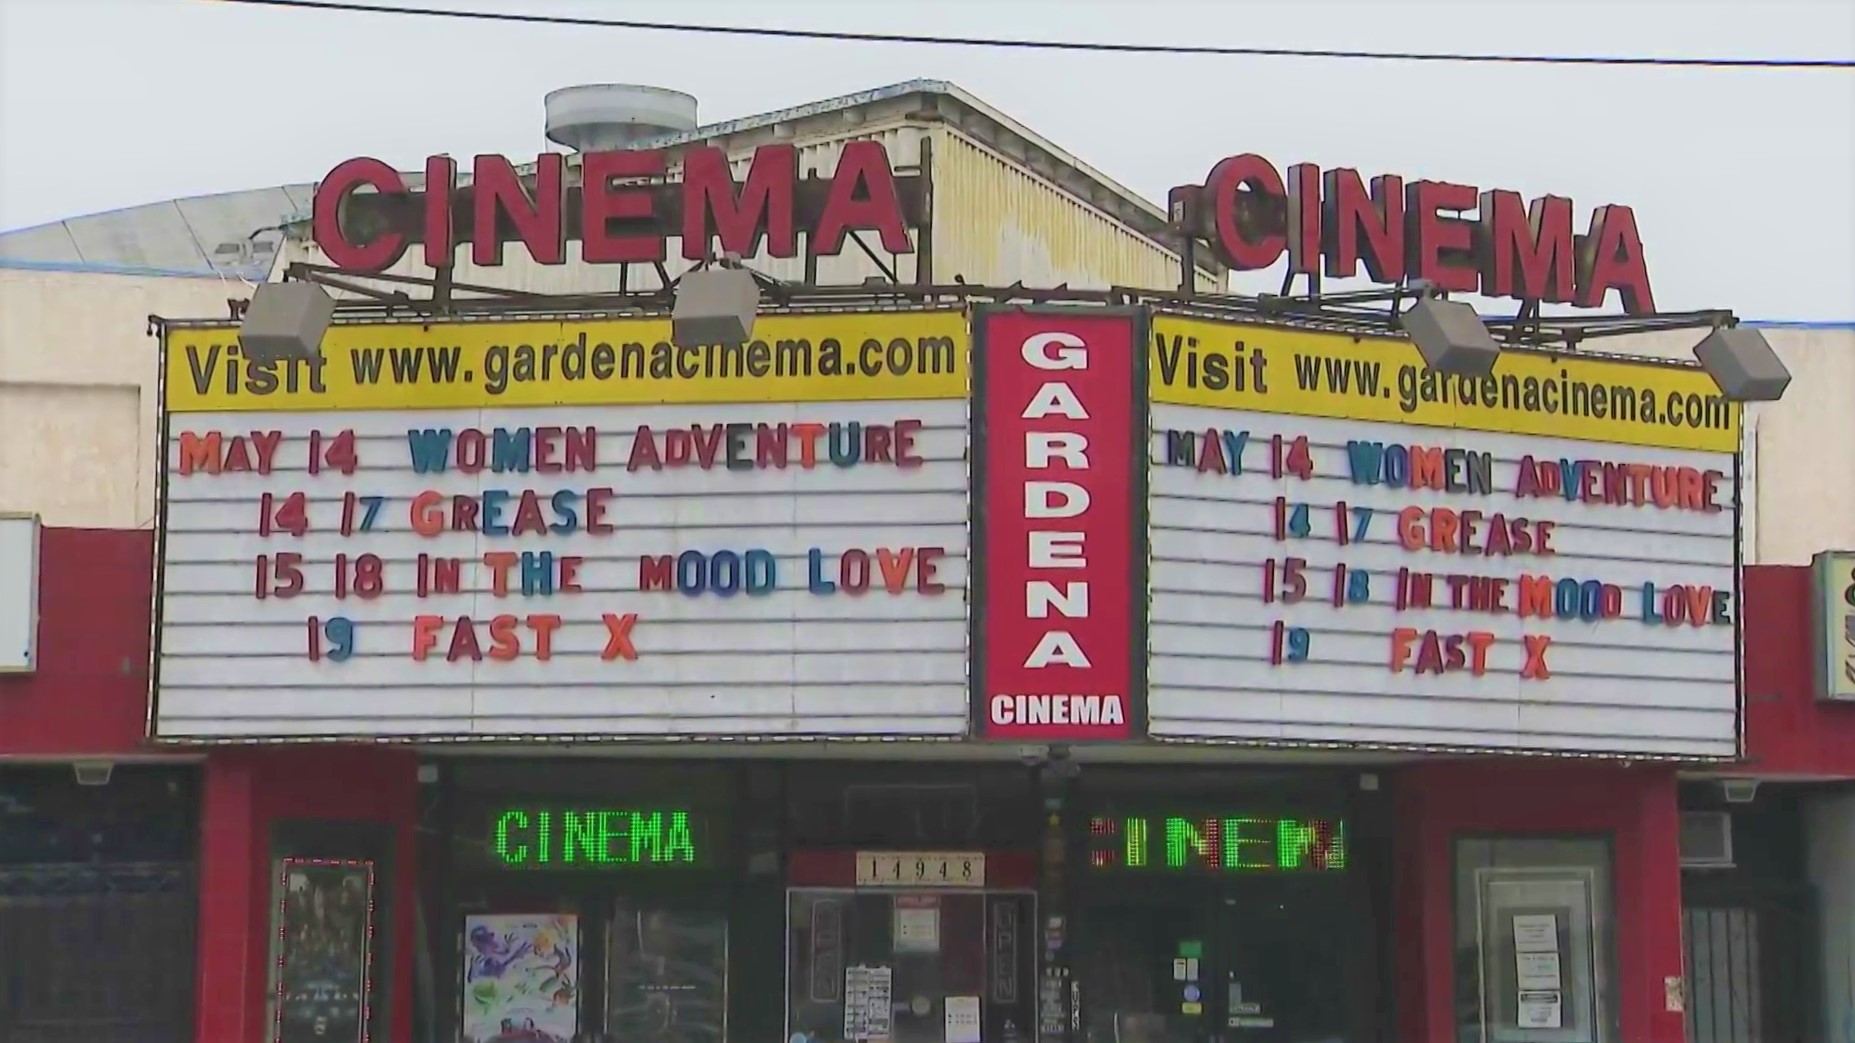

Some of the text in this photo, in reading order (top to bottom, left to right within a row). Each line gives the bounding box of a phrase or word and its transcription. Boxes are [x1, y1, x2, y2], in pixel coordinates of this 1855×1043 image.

[313, 138, 916, 272] CINEMA
[1205, 153, 1655, 316] CINEMA
[185, 332, 955, 395] Visit www.gardenacinema.com
[1155, 333, 1730, 432] Visit www.gardenacinema.com
[178, 419, 923, 476] MAY 14 WOMEN ADVENTURE
[1167, 427, 1724, 513] MAY 14 WOMEN ADVENTURE
[258, 486, 614, 538] 14 17 GREASE
[1020, 330, 1092, 670] GARDENA
[1274, 496, 1556, 557] 14 17 GREASE
[255, 546, 945, 600] 15 18 IN THE MOOD LOVE
[1263, 557, 1732, 626] 15 18 IN THE MOOD LOVE
[307, 612, 639, 663] 19 FAST X
[1271, 619, 1552, 680] 19 FAST X
[990, 693, 1124, 726] CINEMA
[495, 810, 695, 863] CINEMA
[871, 855, 973, 881] 14948
